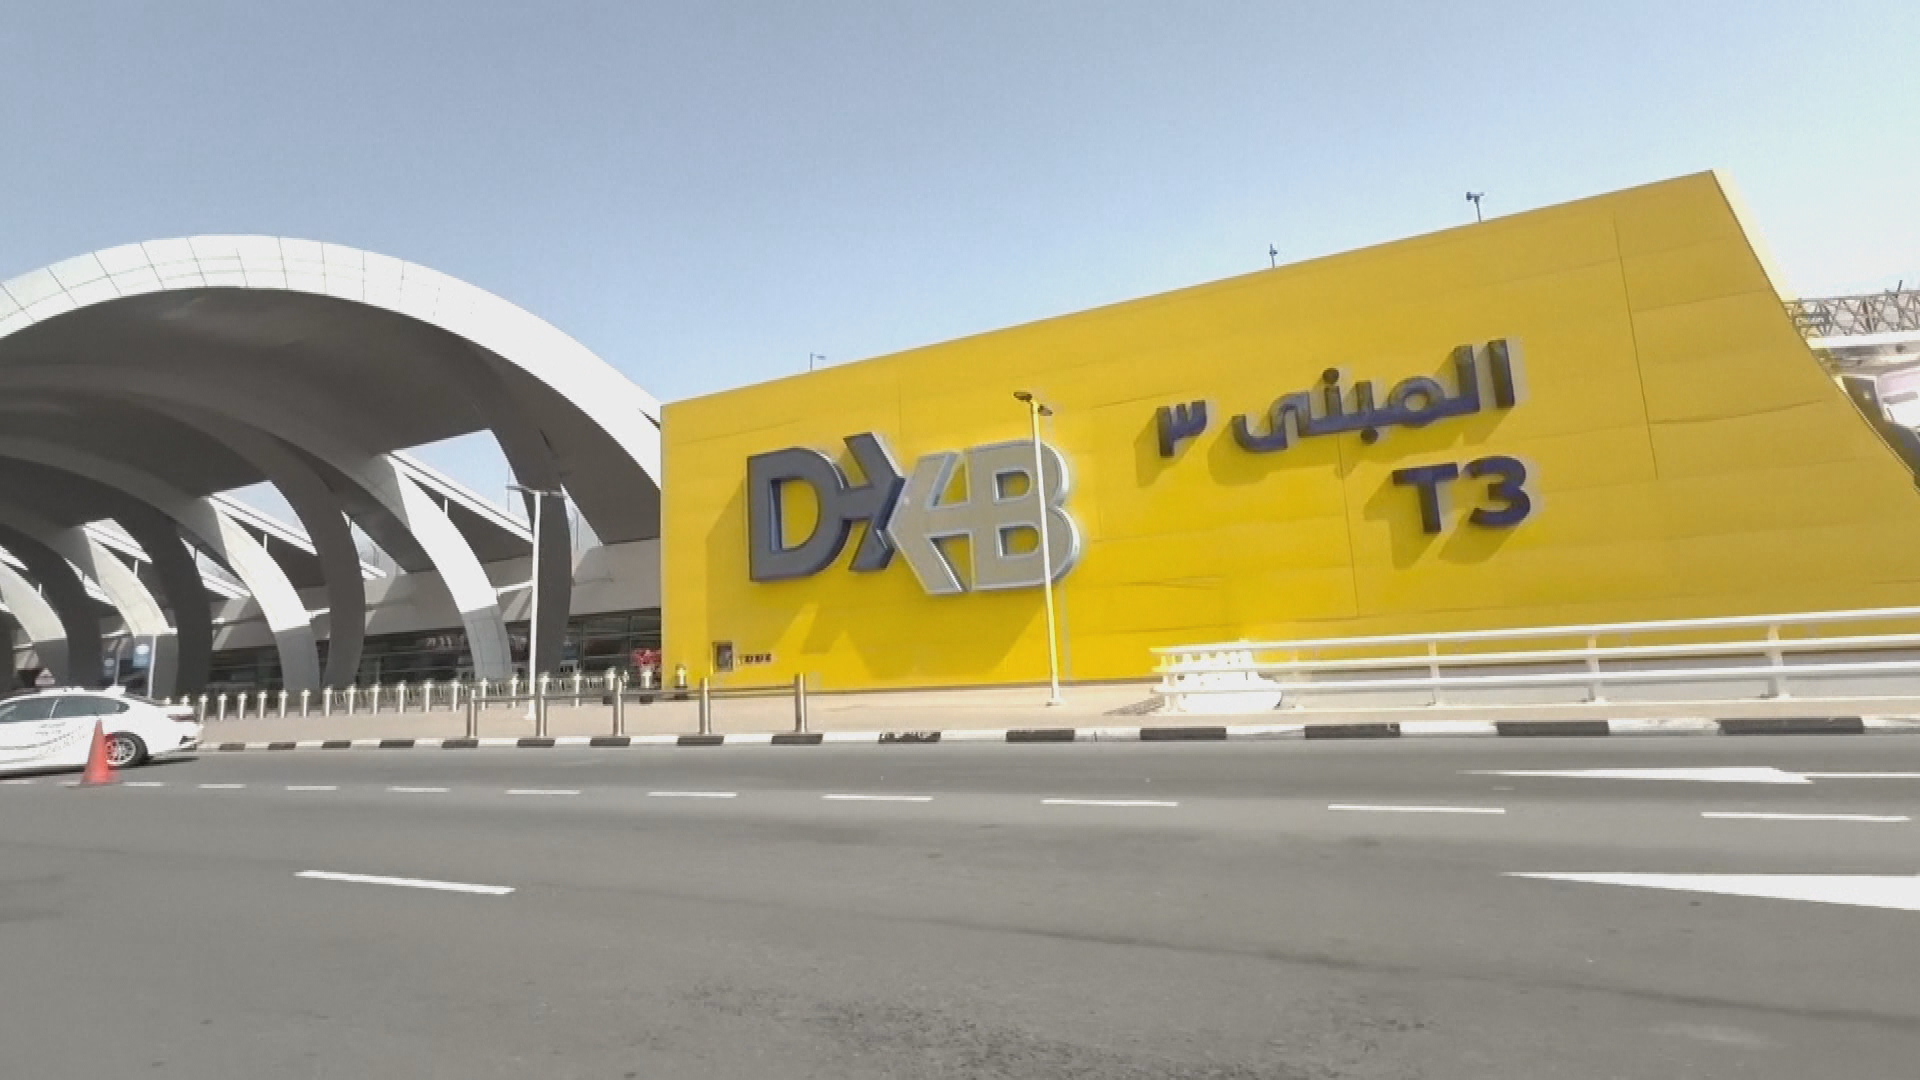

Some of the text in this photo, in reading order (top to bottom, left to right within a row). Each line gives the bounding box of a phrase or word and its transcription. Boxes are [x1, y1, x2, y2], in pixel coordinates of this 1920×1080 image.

[1156, 338, 1515, 459] المبنى ٣
[746, 431, 1081, 595] DXB
[1392, 455, 1532, 535] T3
